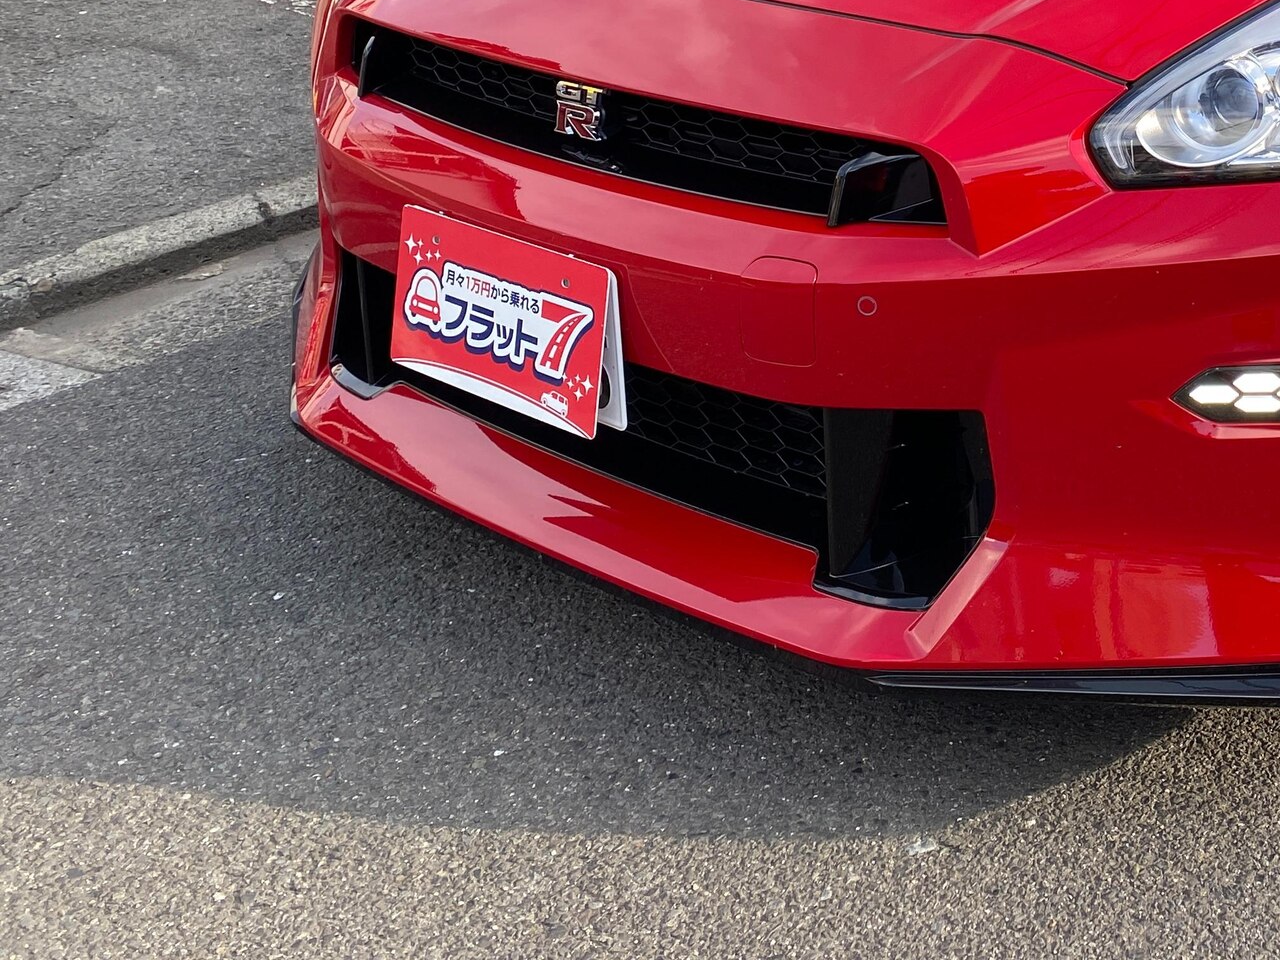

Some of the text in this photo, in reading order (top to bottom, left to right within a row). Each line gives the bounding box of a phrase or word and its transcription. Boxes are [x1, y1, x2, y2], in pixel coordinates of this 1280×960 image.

[556, 80, 603, 105] GT
[554, 100, 601, 141] R
[446, 270, 540, 314] 月々1万円から乗れる
